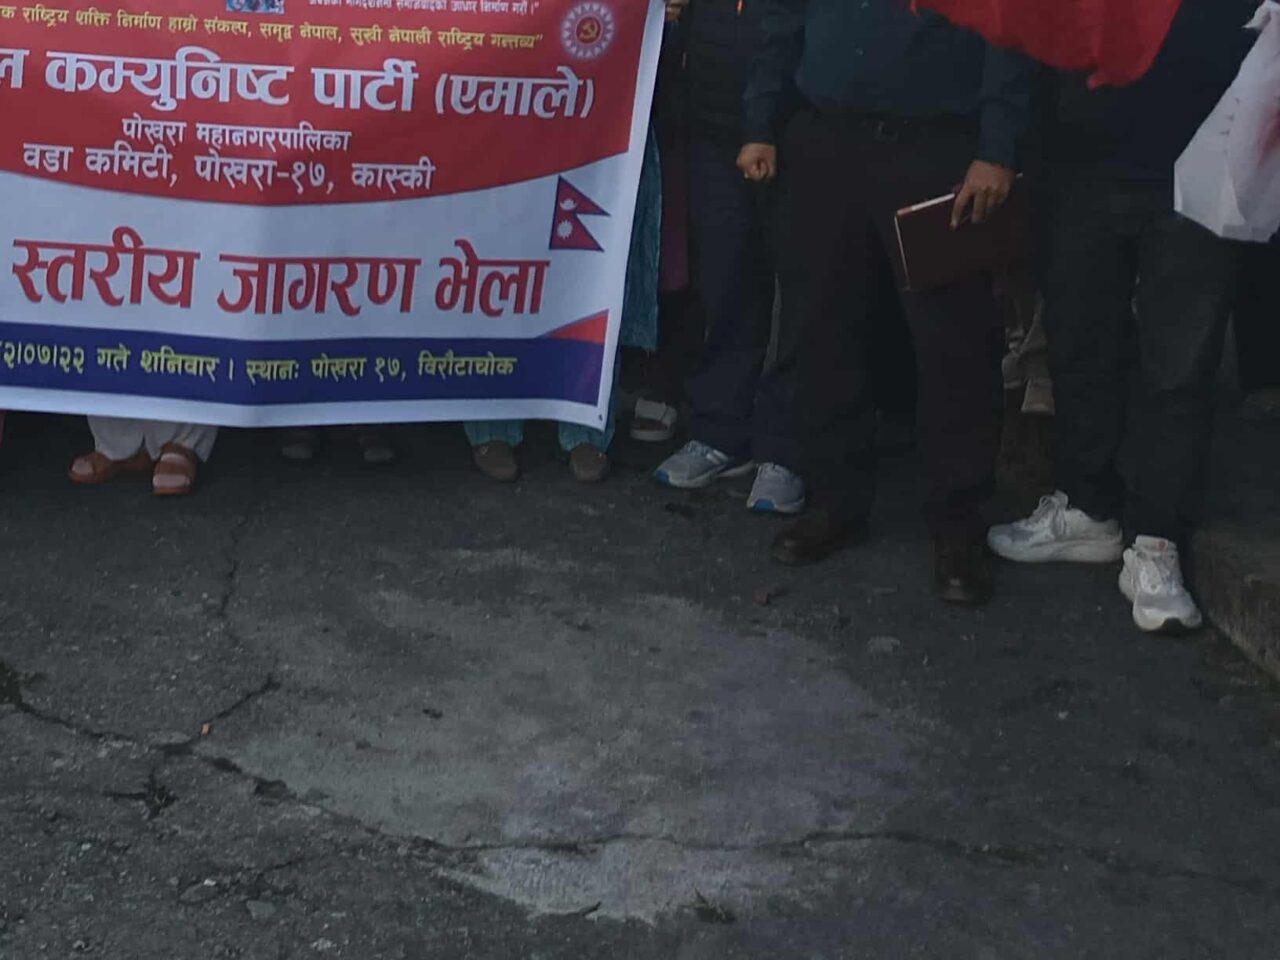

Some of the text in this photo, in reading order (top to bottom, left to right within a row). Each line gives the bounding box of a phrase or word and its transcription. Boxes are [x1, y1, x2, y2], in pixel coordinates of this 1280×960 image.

[117, 9, 162, 29] निर्माण
[168, 14, 197, 33] हाम्रो
[300, 22, 342, 43] नेपाल,
[350, 25, 382, 46] सुखी
[389, 26, 432, 45] नेपाली
[45, 46, 294, 111] कम्युनिष्ट
[311, 58, 418, 112] पार्टी
[435, 66, 594, 119] (एमाले)
[122, 113, 352, 153] पोखरा महानगरपालिका
[23, 143, 73, 173] वडा
[85, 141, 178, 187] कमिटी,
[351, 157, 436, 190] कास्की
[12, 226, 201, 309] स्तरीय
[217, 254, 422, 317] जागरण
[435, 239, 551, 317] भेला
[96, 343, 131, 371] गते
[139, 348, 220, 383] शनिवार
[311, 352, 368, 381] पोखरा
